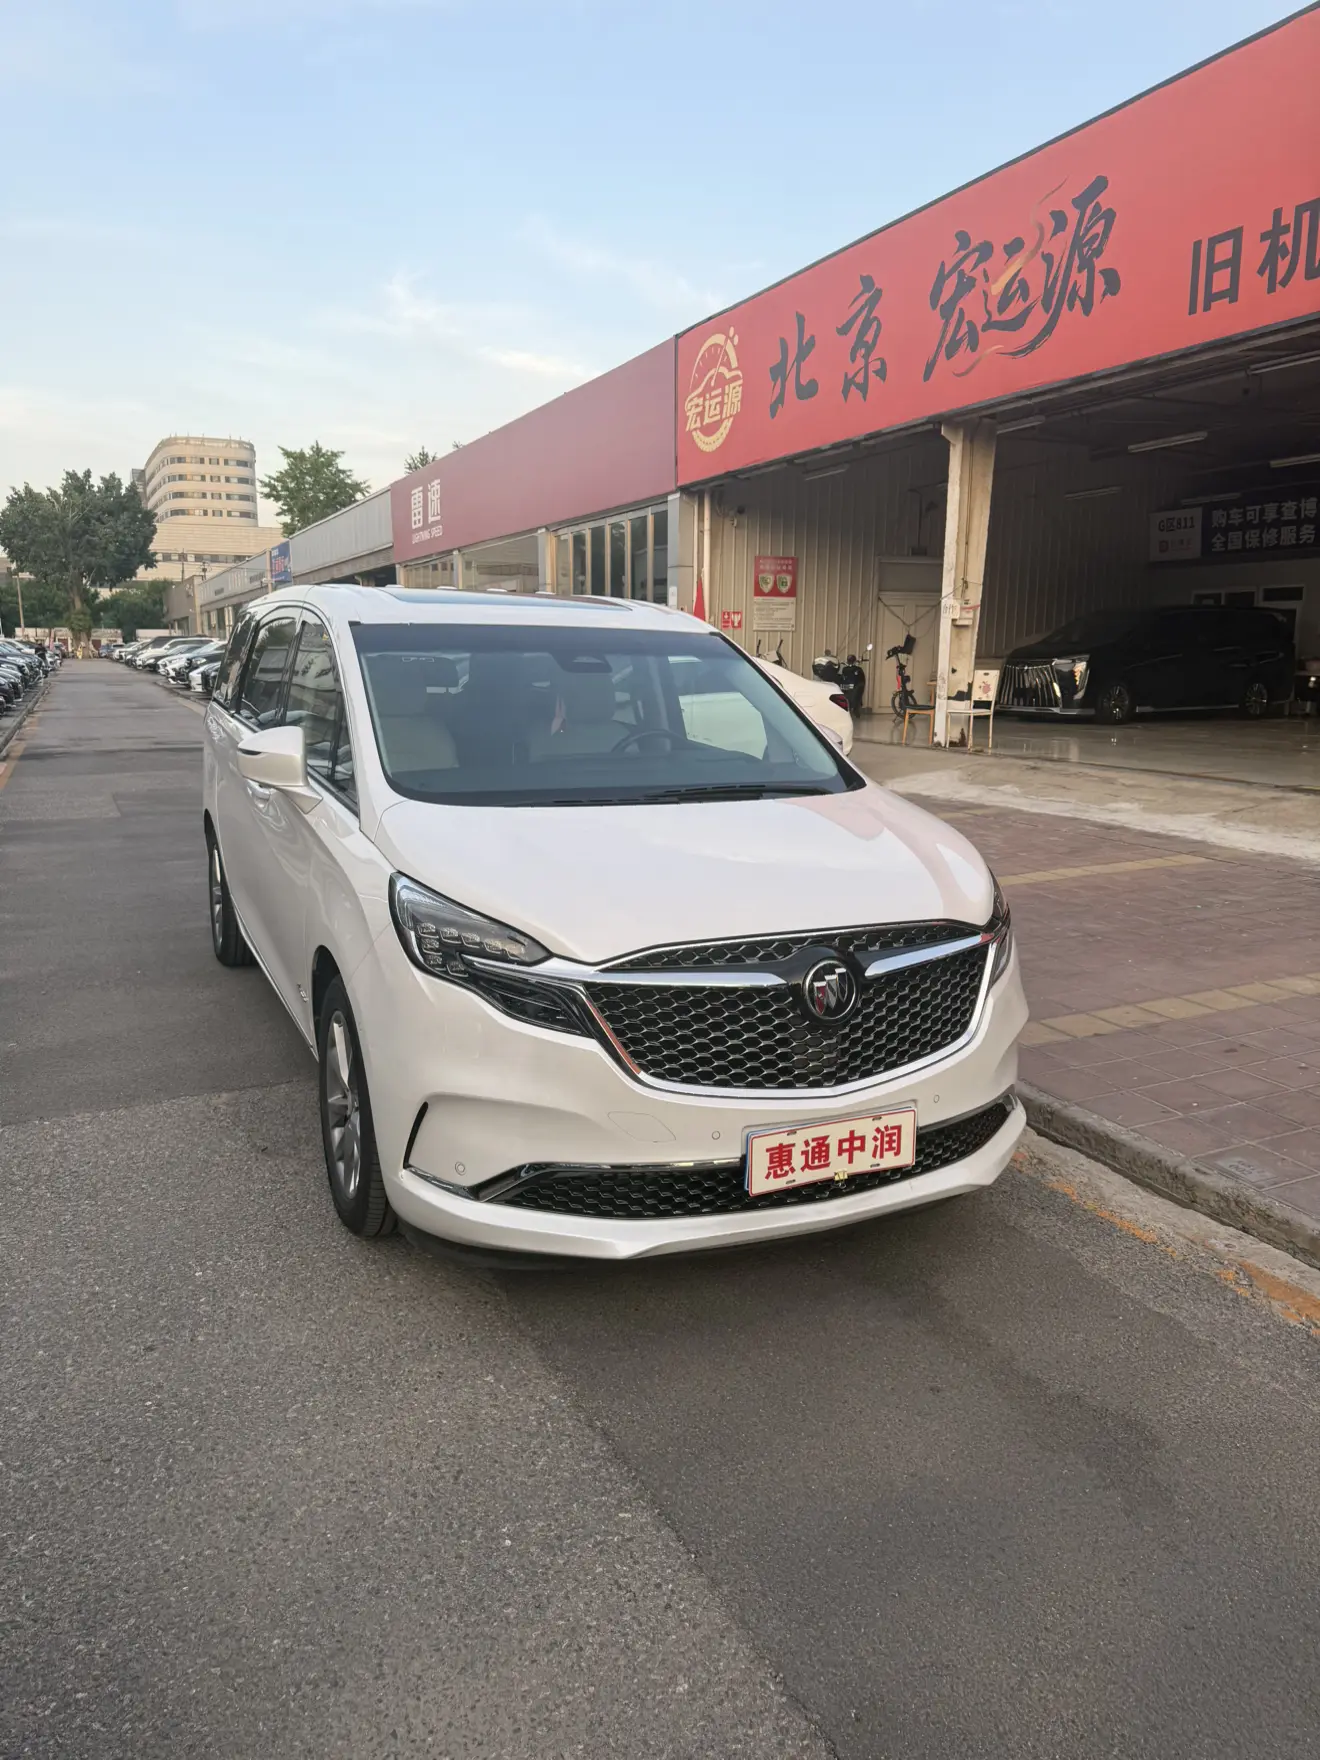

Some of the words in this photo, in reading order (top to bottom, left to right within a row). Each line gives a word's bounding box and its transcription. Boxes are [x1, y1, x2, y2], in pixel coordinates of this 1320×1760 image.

[769, 275, 887, 419] 北京
[924, 175, 1121, 382] 宏运源
[1188, 197, 1320, 316] 旧机
[686, 379, 743, 432] 宏运源
[1211, 524, 1316, 551] 全国保修服务
[765, 1125, 902, 1180] 惠通中润
